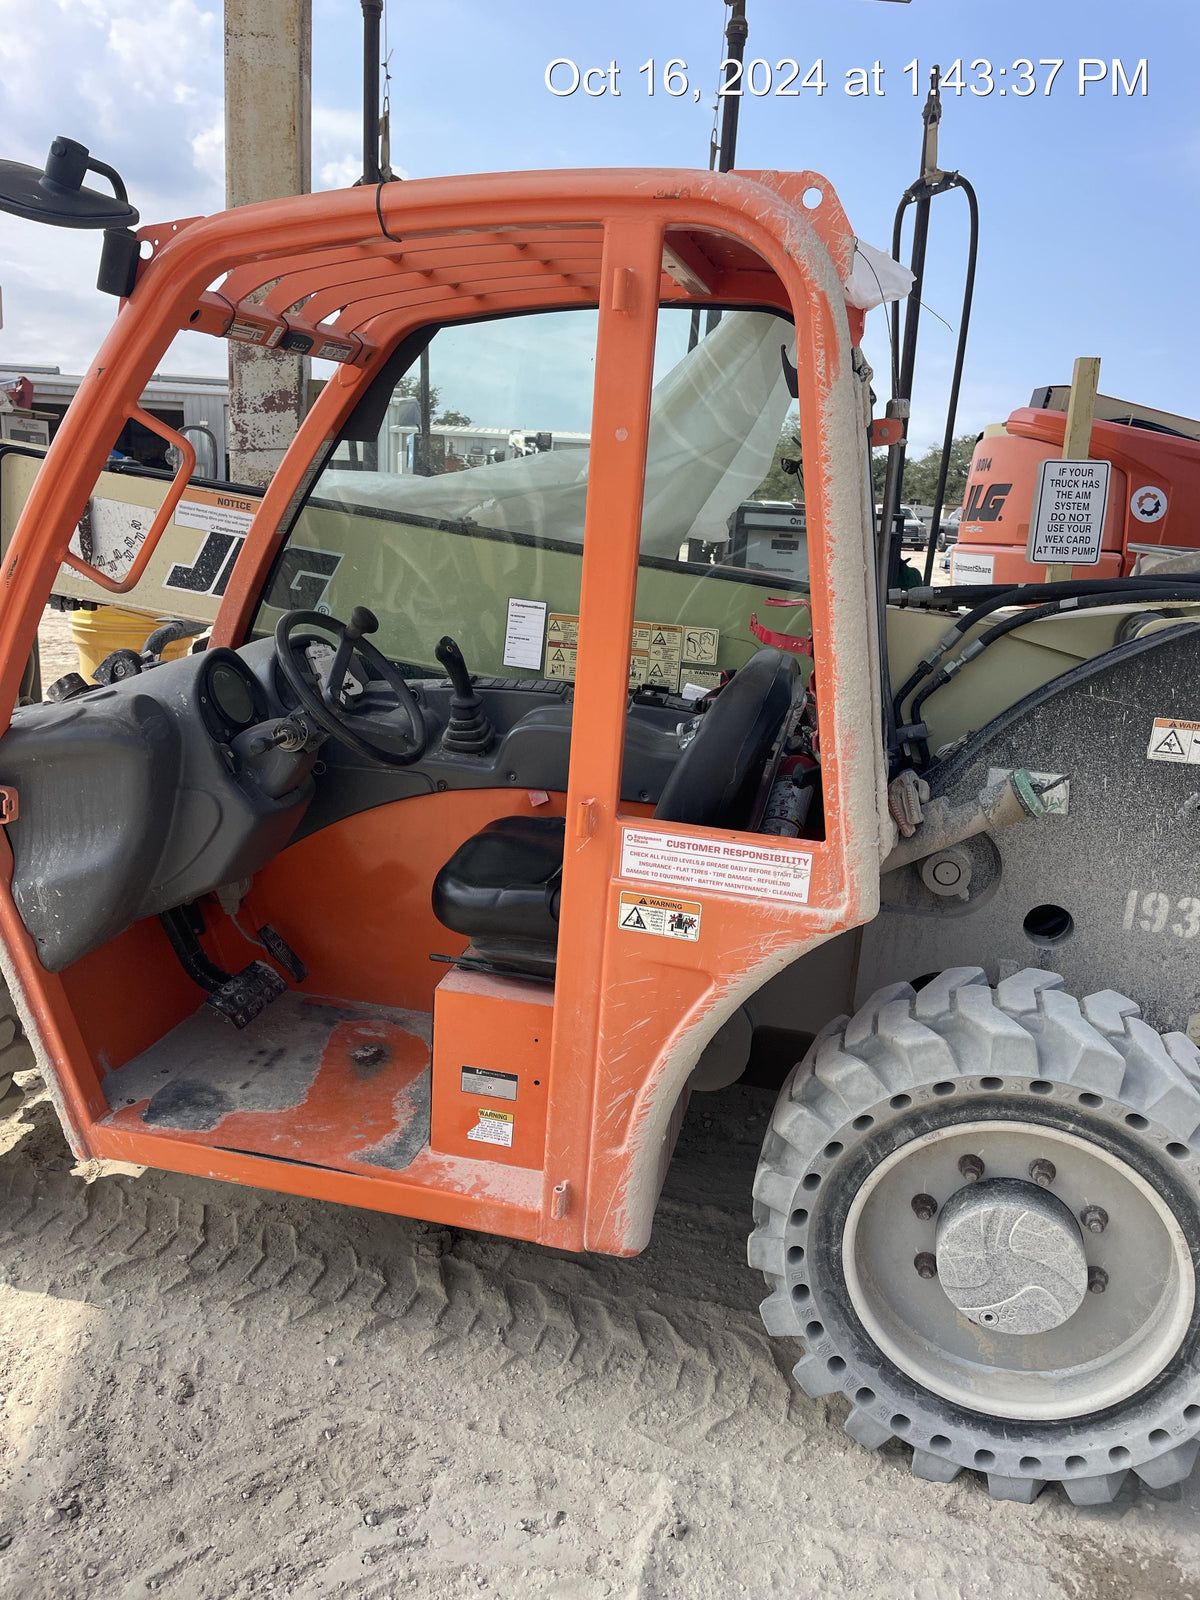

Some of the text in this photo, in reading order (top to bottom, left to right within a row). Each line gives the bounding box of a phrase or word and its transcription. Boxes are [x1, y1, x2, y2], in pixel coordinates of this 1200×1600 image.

[1058, 468, 1094, 477] IF YOUR
[1050, 479, 1100, 488] TRUCK HAS
[1056, 491, 1091, 499] THE AIM
[218, 497, 252, 510] NOTICE
[1054, 502, 1090, 510] SYSTEM
[1050, 513, 1091, 522] DO NOT
[131, 520, 142, 530] 80
[1047, 524, 1092, 533] USE YOUR
[124, 536, 135, 548] 60
[134, 532, 146, 543] 70
[1045, 535, 1090, 544] WEX CARD
[113, 549, 122, 560] 40
[124, 549, 134, 561] 50
[1036, 546, 1096, 555] AT THIS PUMP
[97, 555, 106, 566] 20
[108, 560, 117, 572] 30
[633, 834, 662, 842] Equipment
[666, 840, 809, 866] CUSTOMER RESPONSIBILITY
[630, 850, 649, 858] CHECK
[706, 861, 729, 869] GREASE
[749, 867, 772, 876] BEFORE
[639, 861, 672, 870] INSURANCE
[728, 873, 752, 882] DAMAGE
[757, 878, 790, 887] REFUELING
[626, 868, 649, 876] DAMAGE
[660, 873, 694, 883] EQUIPMENT
[698, 878, 723, 886] BATTERY
[724, 882, 768, 893] MAINTENANCE
[772, 889, 803, 898] CLEANING
[649, 899, 682, 910] WARNING
[479, 1110, 508, 1120] WARNING
